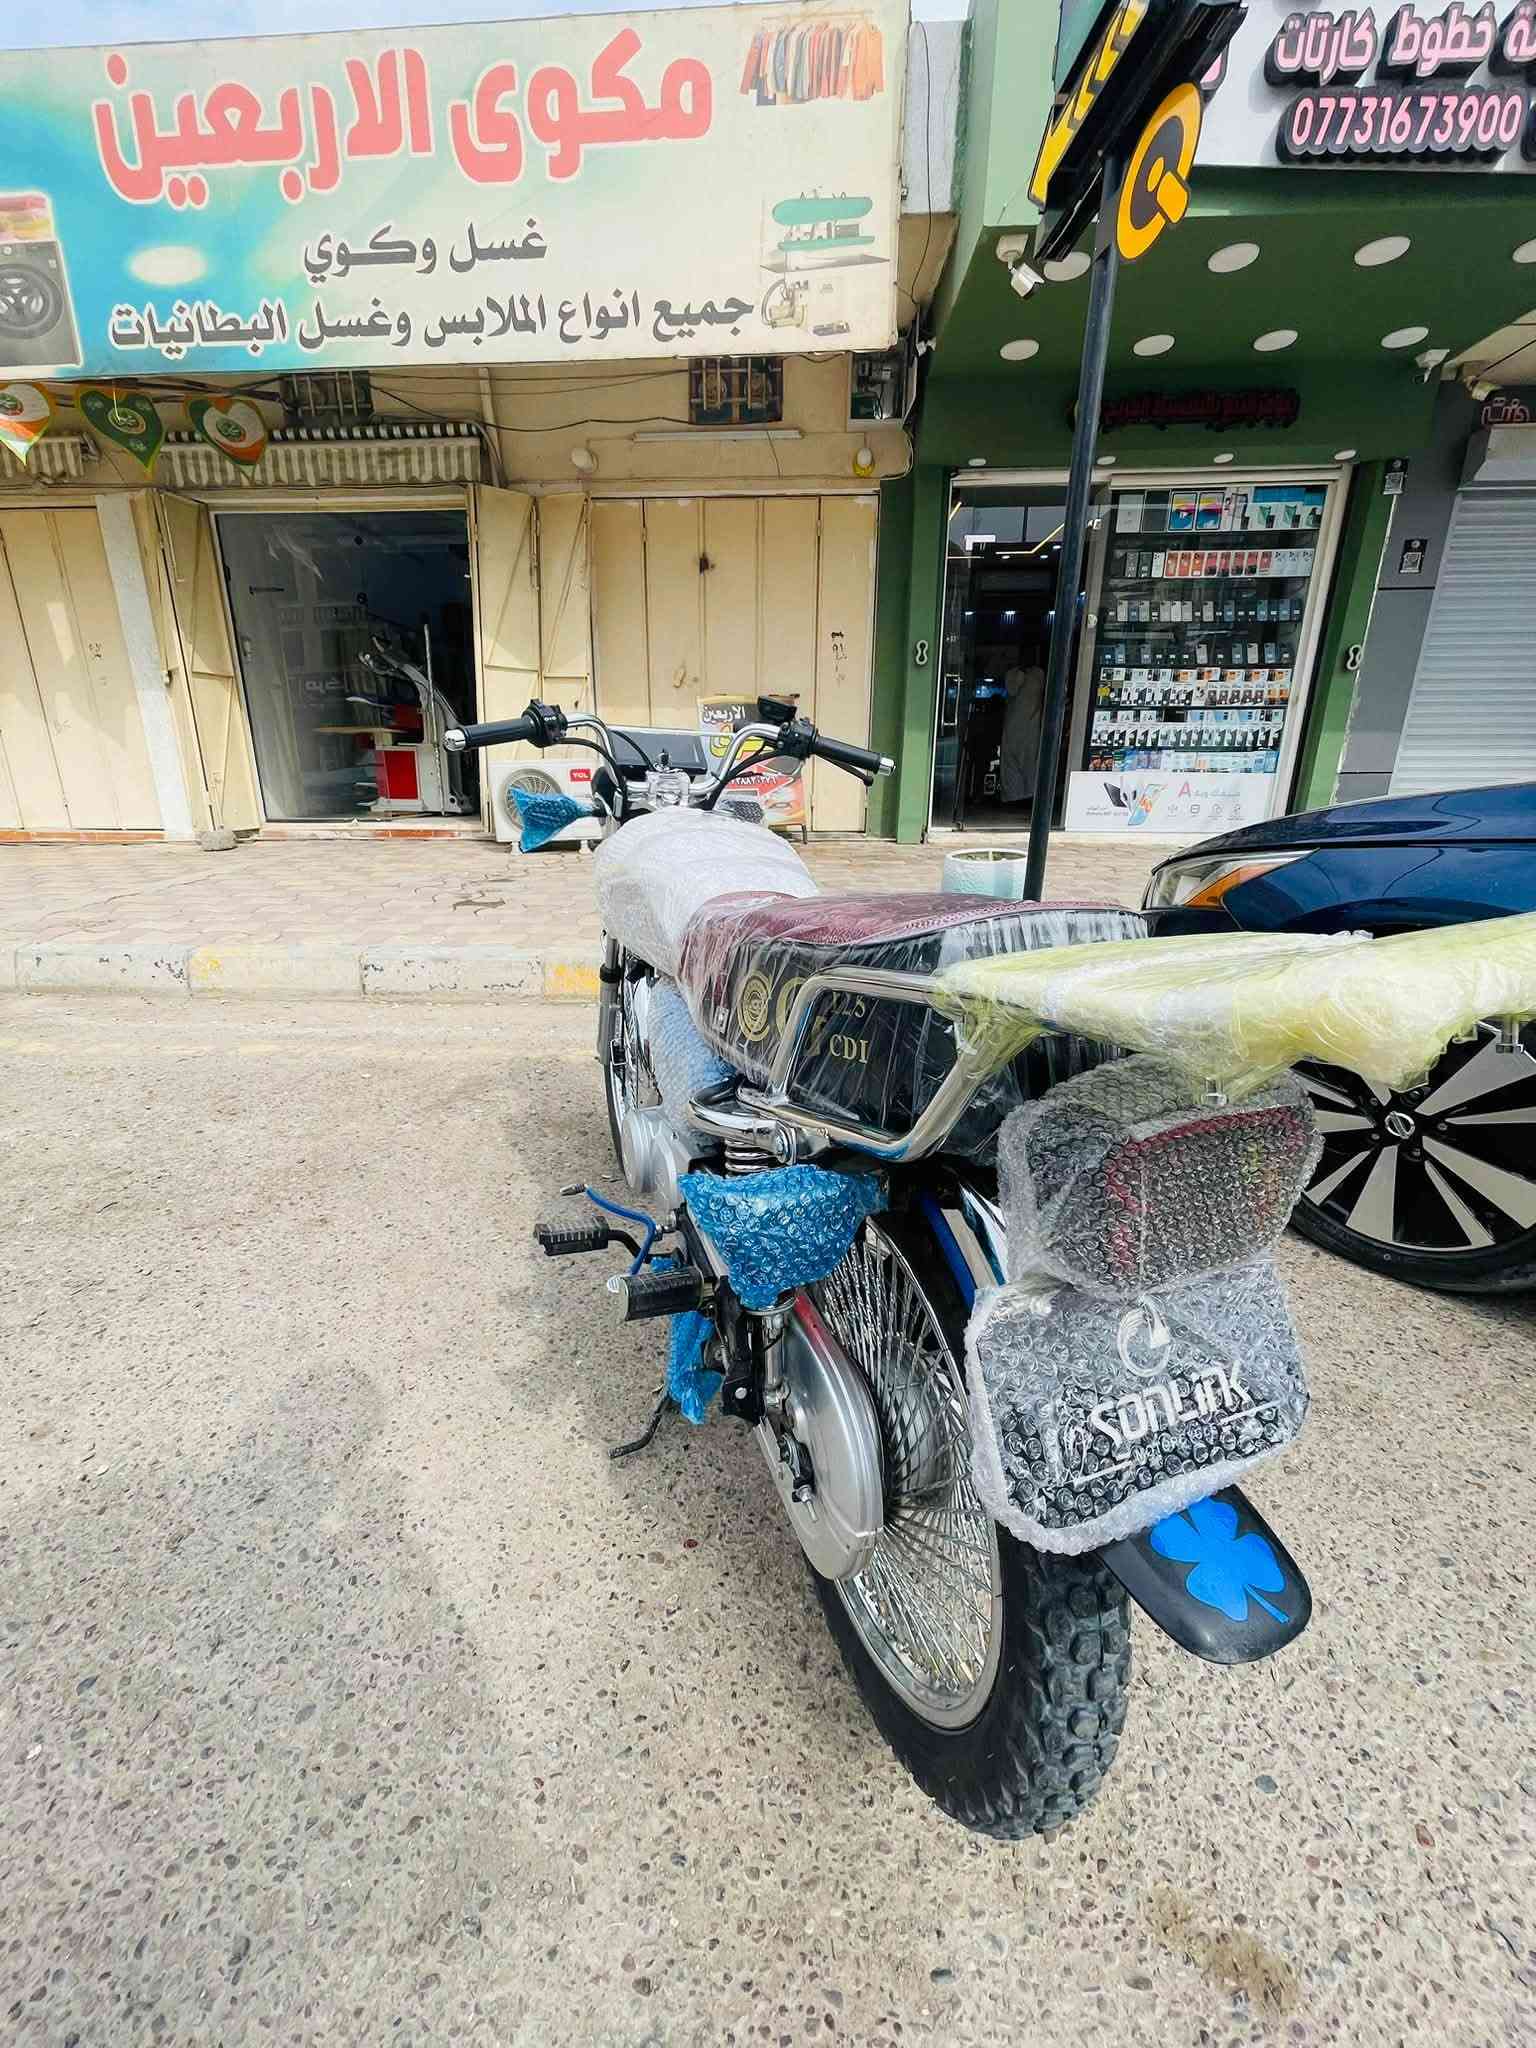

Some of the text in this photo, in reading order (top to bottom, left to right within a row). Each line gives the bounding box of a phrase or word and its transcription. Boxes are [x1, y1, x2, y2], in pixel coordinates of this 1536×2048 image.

[1277, 15, 1375, 84] كارتات
[1391, 7, 1492, 74] خطوط
[95, 48, 433, 207] الاربعين
[1291, 94, 1523, 146] 07731673900
[304, 218, 548, 284] غسل وكوي
[111, 288, 755, 354] جميع انواع الملابس وغسل البطانيات
[571, 769, 590, 777] TCL
[829, 1033, 869, 1065] CDI
